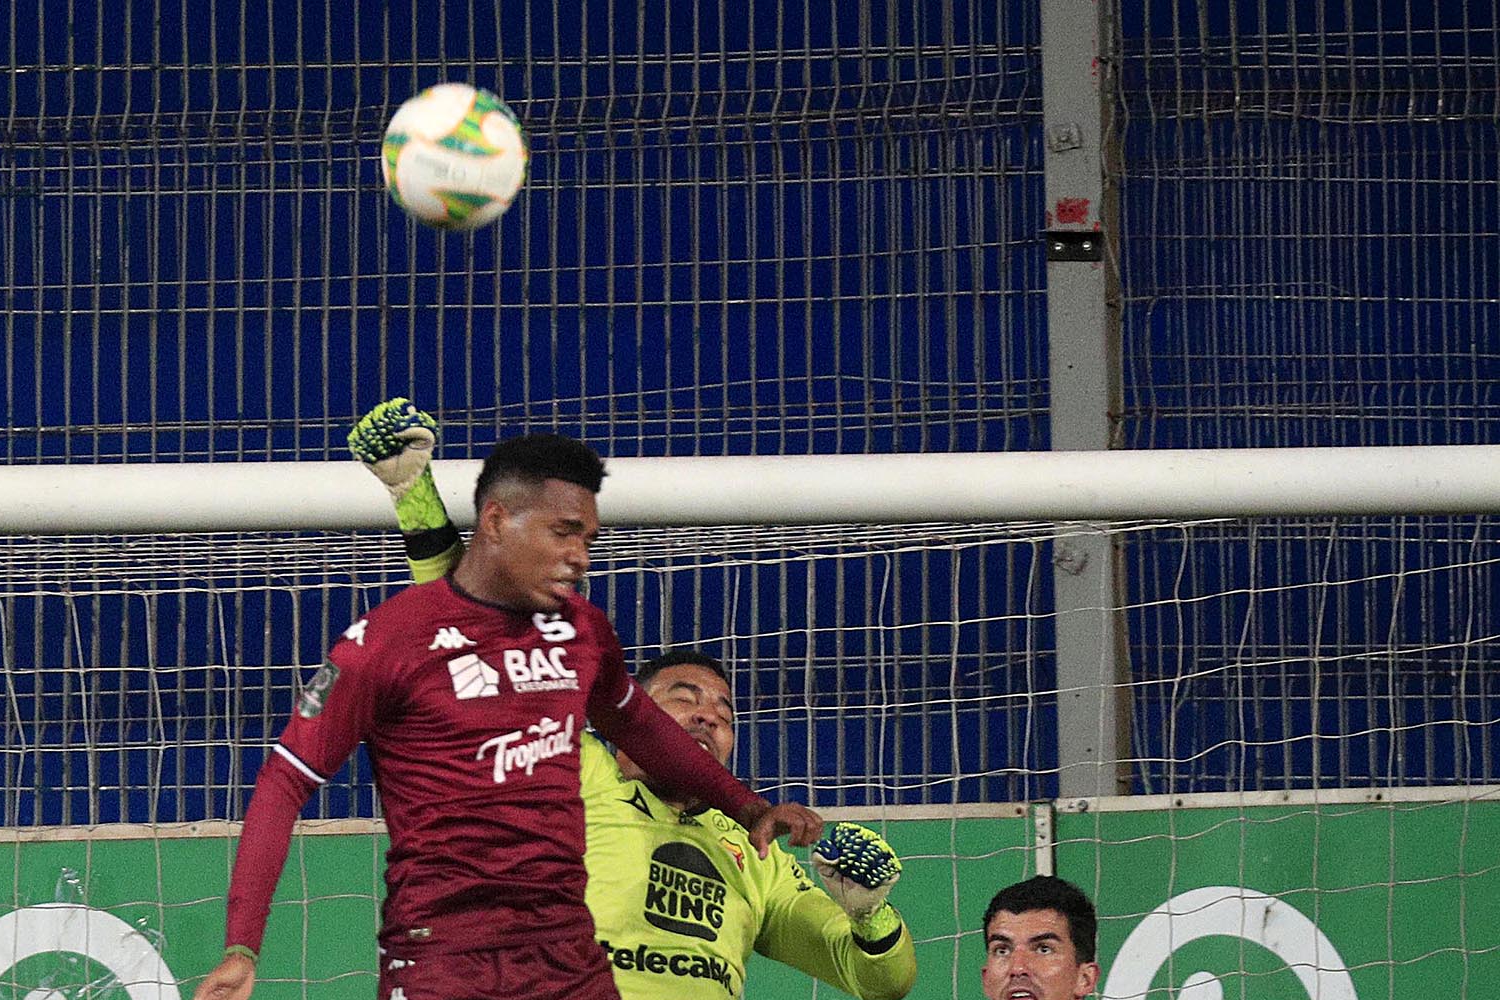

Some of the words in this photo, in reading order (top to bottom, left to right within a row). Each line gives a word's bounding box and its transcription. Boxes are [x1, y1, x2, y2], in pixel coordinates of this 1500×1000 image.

[503, 647, 577, 683] BAC
[476, 713, 575, 783] Tropical
[645, 883, 724, 930] KING
[649, 862, 727, 906] BURGER
